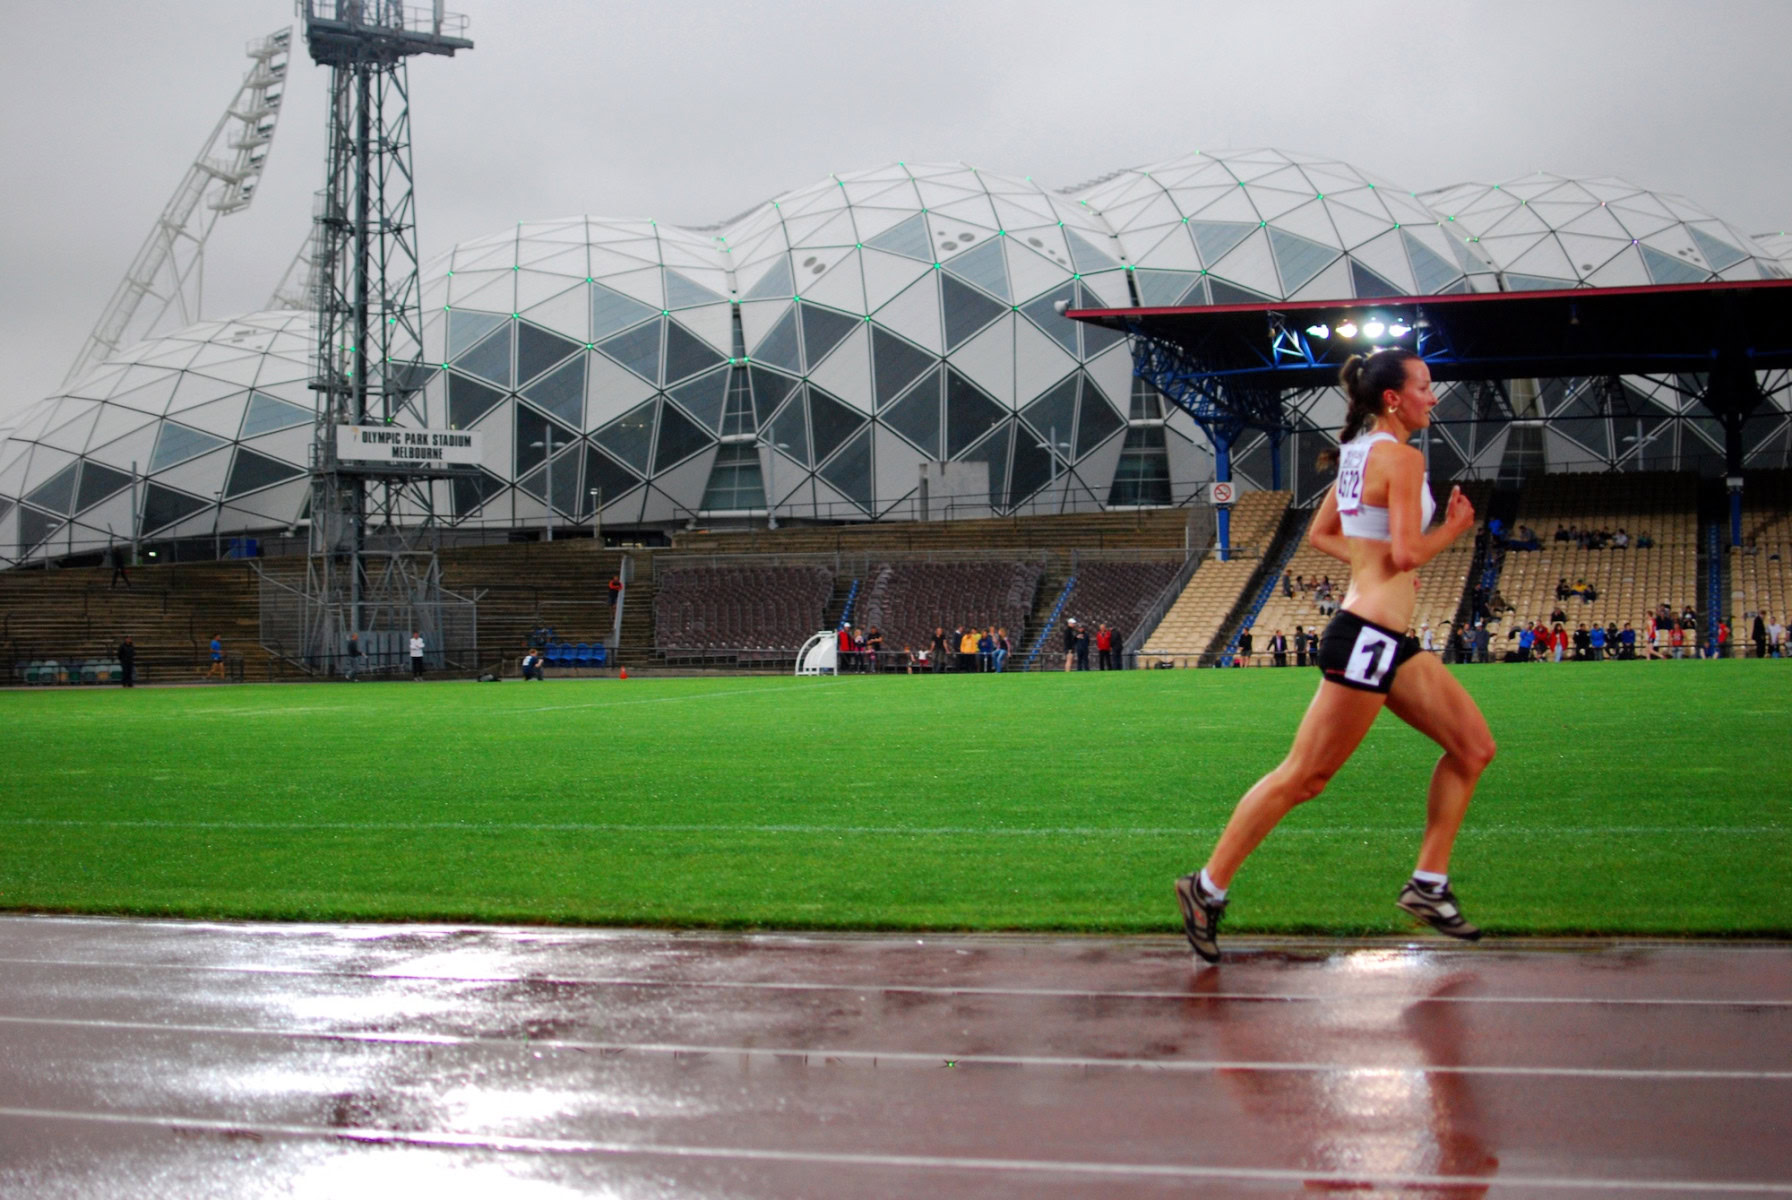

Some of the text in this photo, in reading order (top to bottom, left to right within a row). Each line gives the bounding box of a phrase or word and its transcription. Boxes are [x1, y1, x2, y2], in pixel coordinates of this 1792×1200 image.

[361, 431, 472, 447] OLYMPIC PARK STADIUM
[391, 446, 443, 460] MELBOURNE
[1361, 639, 1387, 681] 1
